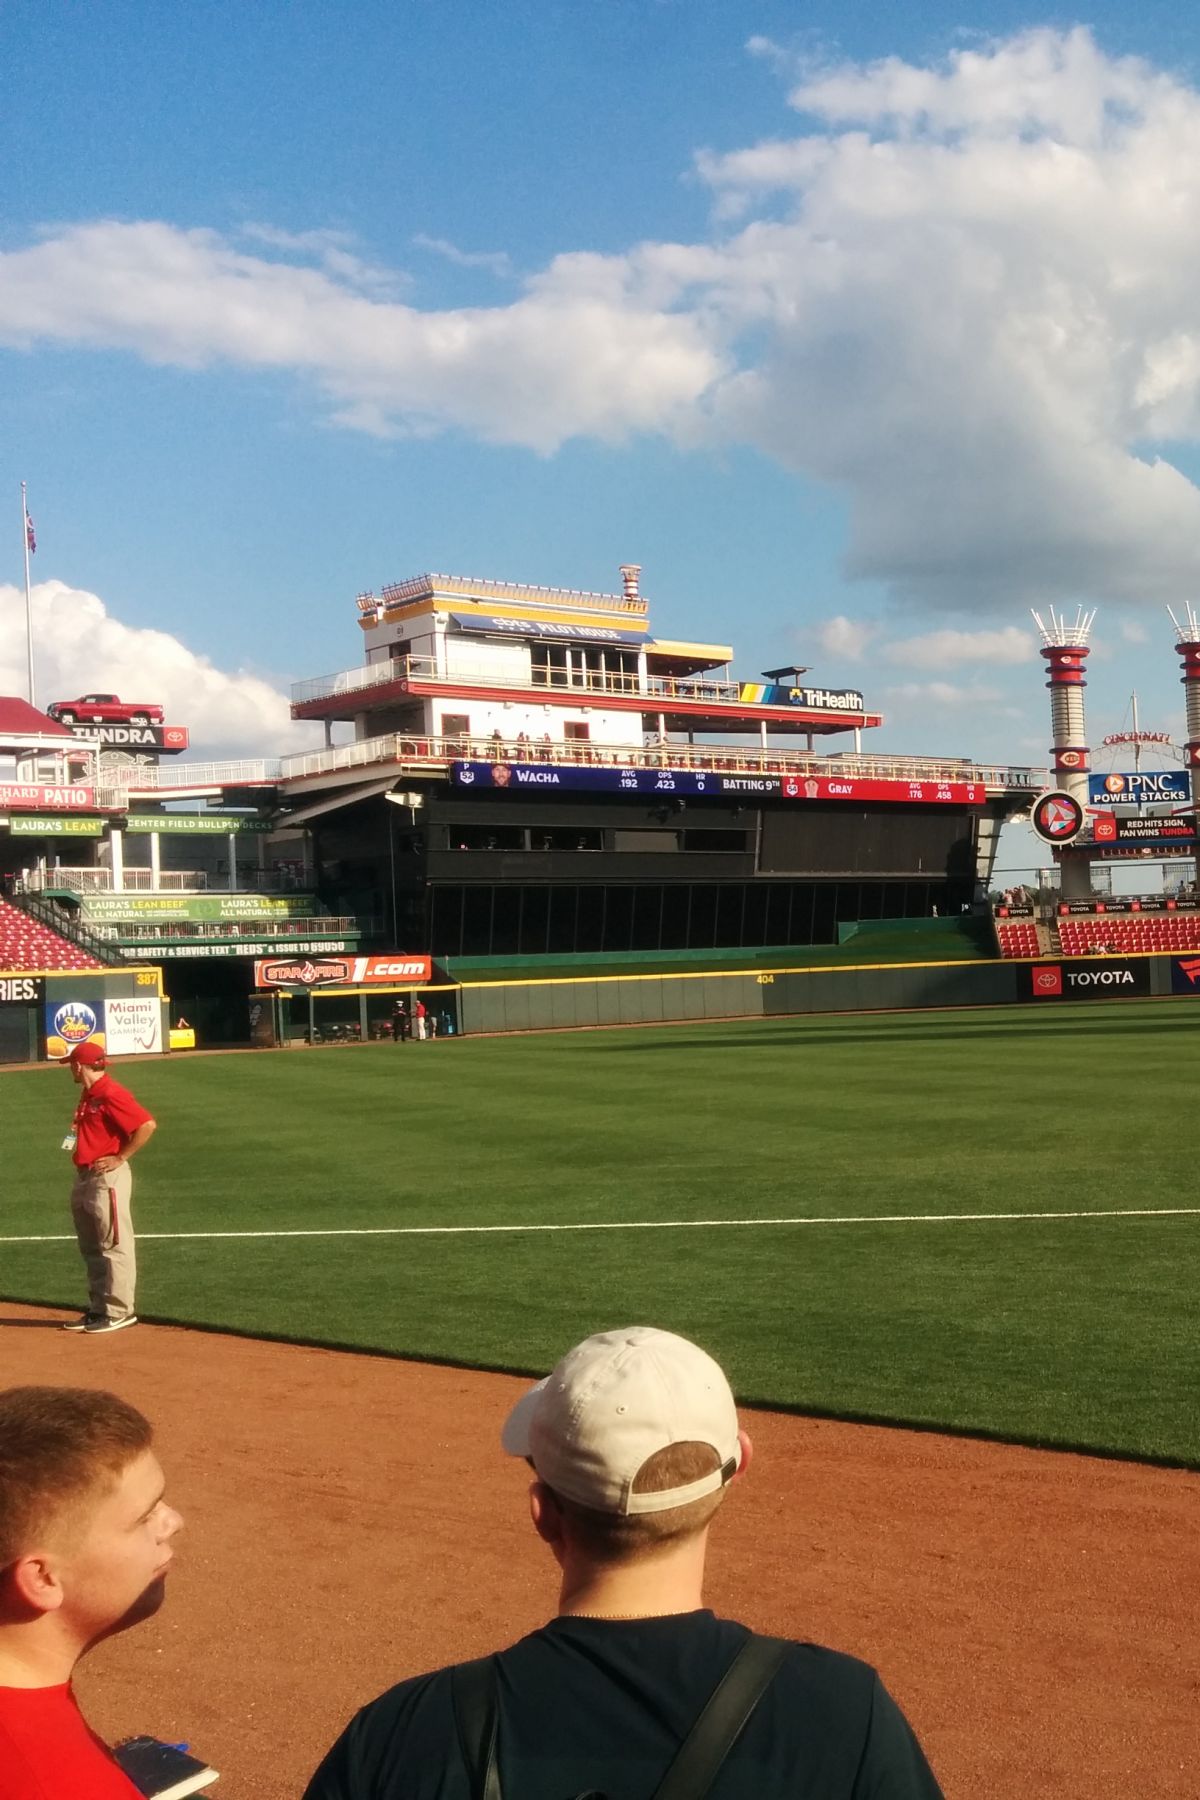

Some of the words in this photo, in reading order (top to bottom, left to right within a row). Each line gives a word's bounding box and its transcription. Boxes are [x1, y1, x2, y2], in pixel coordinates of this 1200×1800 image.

[536, 623, 575, 636] PILOT
[579, 626, 622, 640] HOUSE
[803, 689, 863, 710] TriHealth
[72, 727, 157, 744] TUNDRA
[1103, 731, 1171, 746] CINCINNATI
[621, 770, 636, 778] AVG
[658, 771, 672, 779] OPS
[618, 779, 638, 788] .192
[654, 780, 675, 789] .423
[697, 782, 705, 791] 0
[722, 778, 765, 791] BATTING
[1128, 774, 1174, 792] PNC
[44, 788, 87, 804] PATIO
[1093, 793, 1136, 803] POWER
[1140, 790, 1186, 802] STACKS
[13, 821, 62, 831] LAURA'S
[65, 821, 97, 832] LEAN
[127, 820, 165, 828] CENTER
[168, 821, 196, 829] FIELD
[198, 821, 240, 829] BULLPEN
[243, 822, 273, 830] DECKS
[1127, 820, 1143, 828] RED
[1144, 819, 1163, 828] HITS
[1163, 819, 1186, 828] SIGN,
[1120, 829, 1136, 838] FAN
[1137, 828, 1160, 837] WINS
[1160, 827, 1195, 837] TUNDRA
[89, 900, 131, 910] LAURA'S
[132, 900, 158, 909] LEAN
[160, 900, 184, 909] BEEF
[221, 899, 259, 908] LAURA'S
[260, 899, 285, 908] LEAN
[106, 909, 144, 918] NATURAL
[220, 909, 235, 917] ALL
[237, 908, 272, 916] NATURAL
[137, 946, 166, 956] SAFETY
[168, 946, 175, 956] &
[176, 945, 209, 956] SERVICE
[210, 944, 229, 955] TEXT
[275, 943, 298, 952] ISSUE
[299, 942, 309, 952] TO
[267, 966, 301, 980] STAR
[316, 965, 345, 978] FIRE
[137, 973, 158, 985] 387
[757, 974, 774, 984] 404
[1067, 970, 1134, 987] TOYOTA
[0, 979, 39, 1000] RIES.
[109, 1001, 152, 1013] Miami
[114, 1014, 156, 1027] Valley
[110, 1027, 146, 1036] GAMING
